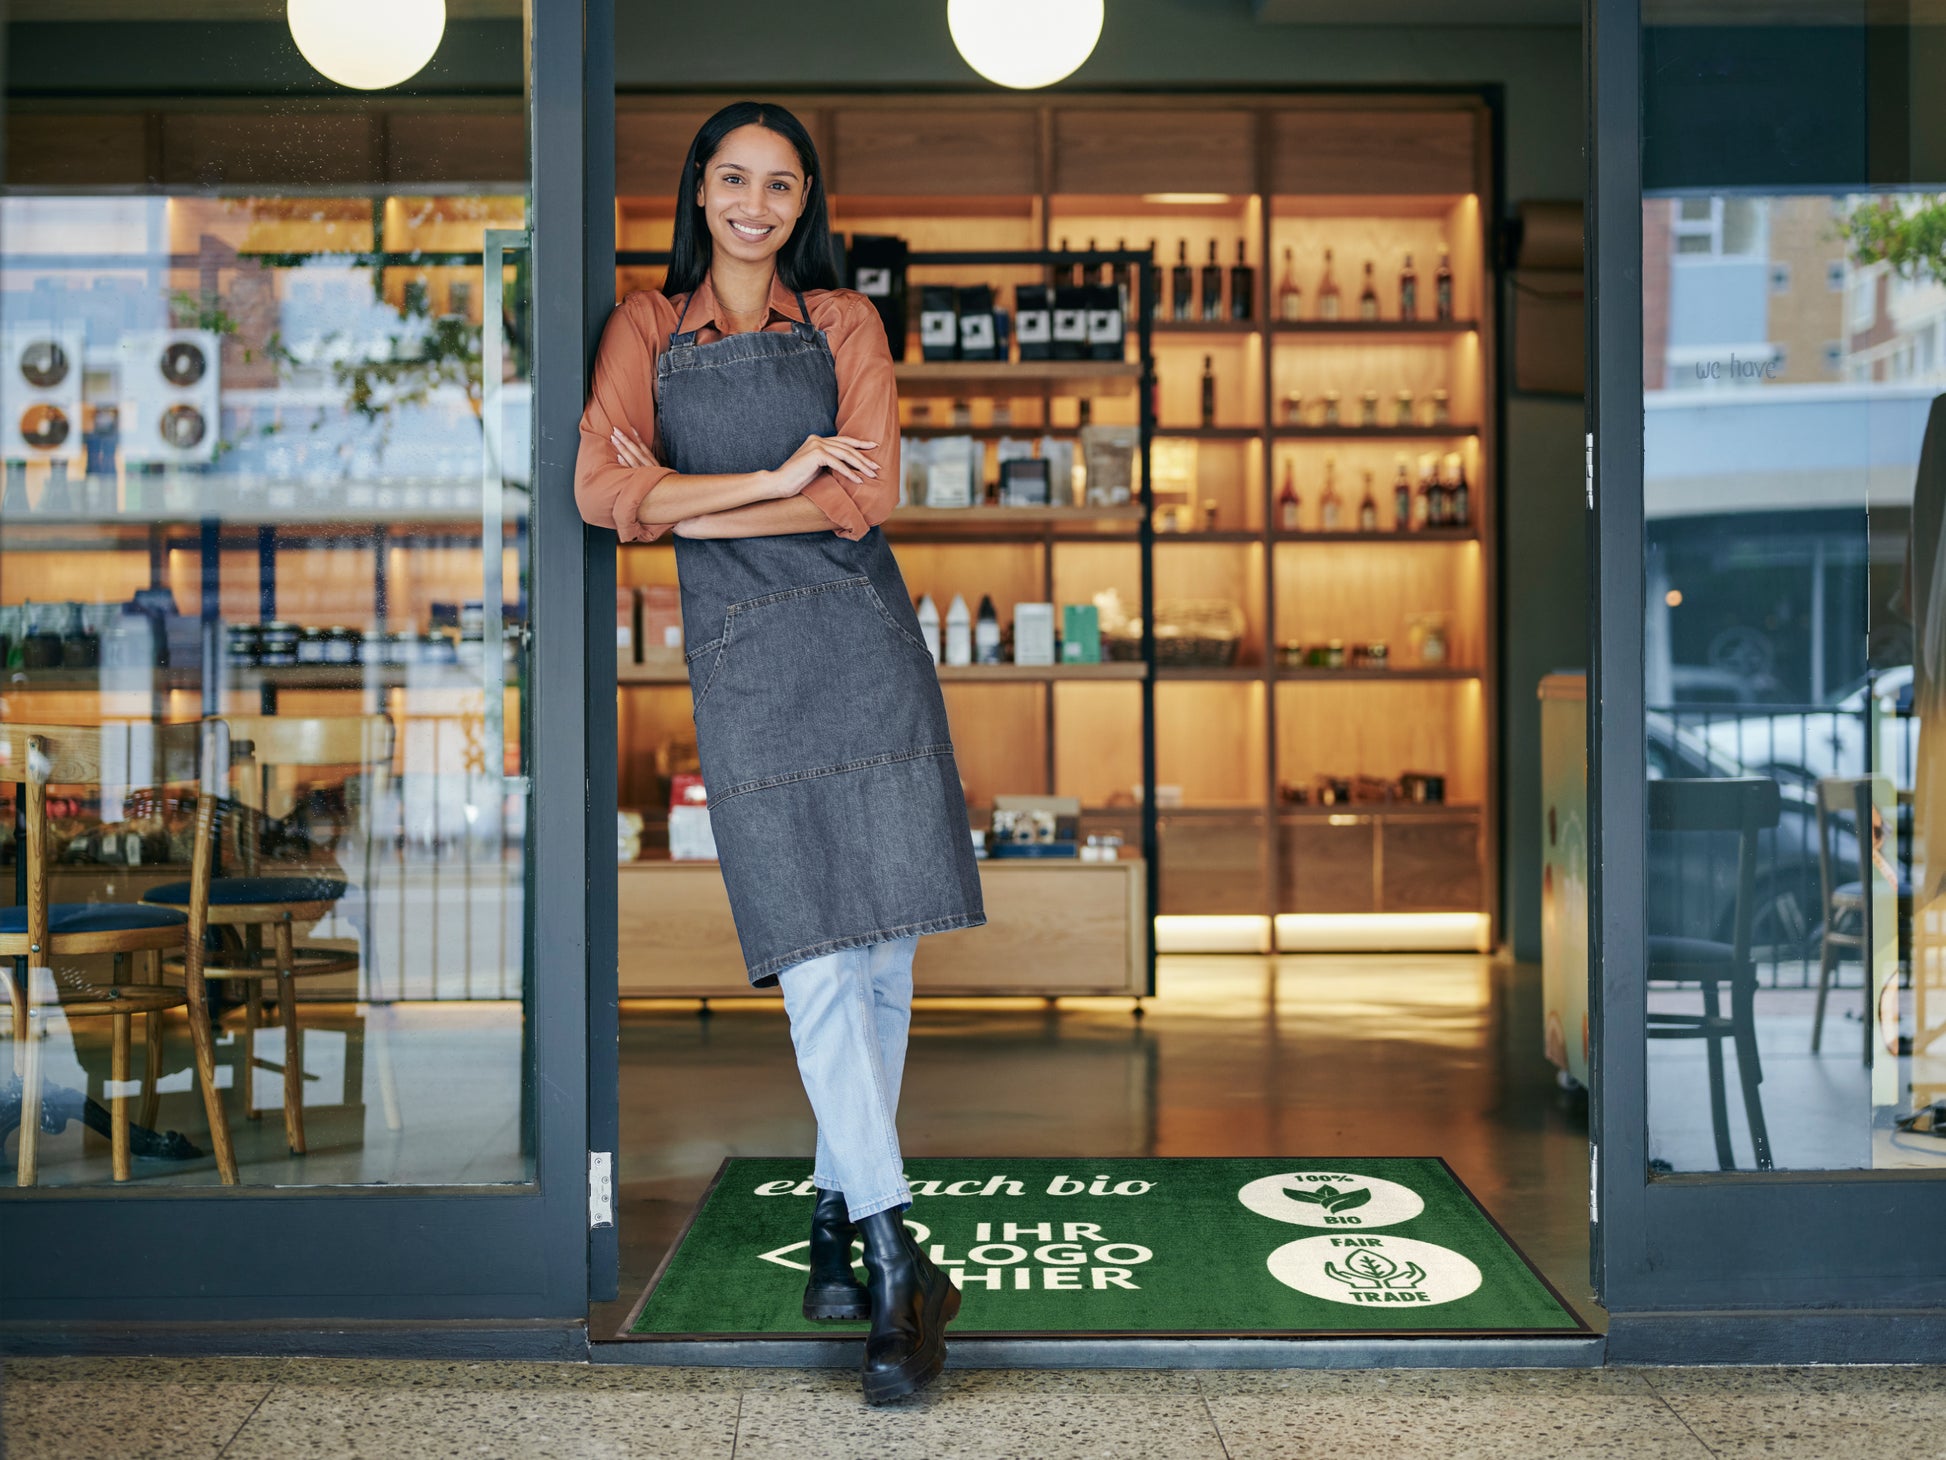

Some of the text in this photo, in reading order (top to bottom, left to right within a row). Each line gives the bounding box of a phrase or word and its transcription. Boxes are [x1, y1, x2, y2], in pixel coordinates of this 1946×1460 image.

[1695, 352, 1776, 379] we have
[753, 1174, 1158, 1196] eiach bio
[1323, 1216, 1362, 1224] BIO
[976, 1222, 1109, 1242] IHR
[1330, 1238, 1384, 1247] FAIR
[930, 1243, 1153, 1265] LOGO
[949, 1267, 1142, 1290] HIER
[1348, 1291, 1431, 1302] TRADE
